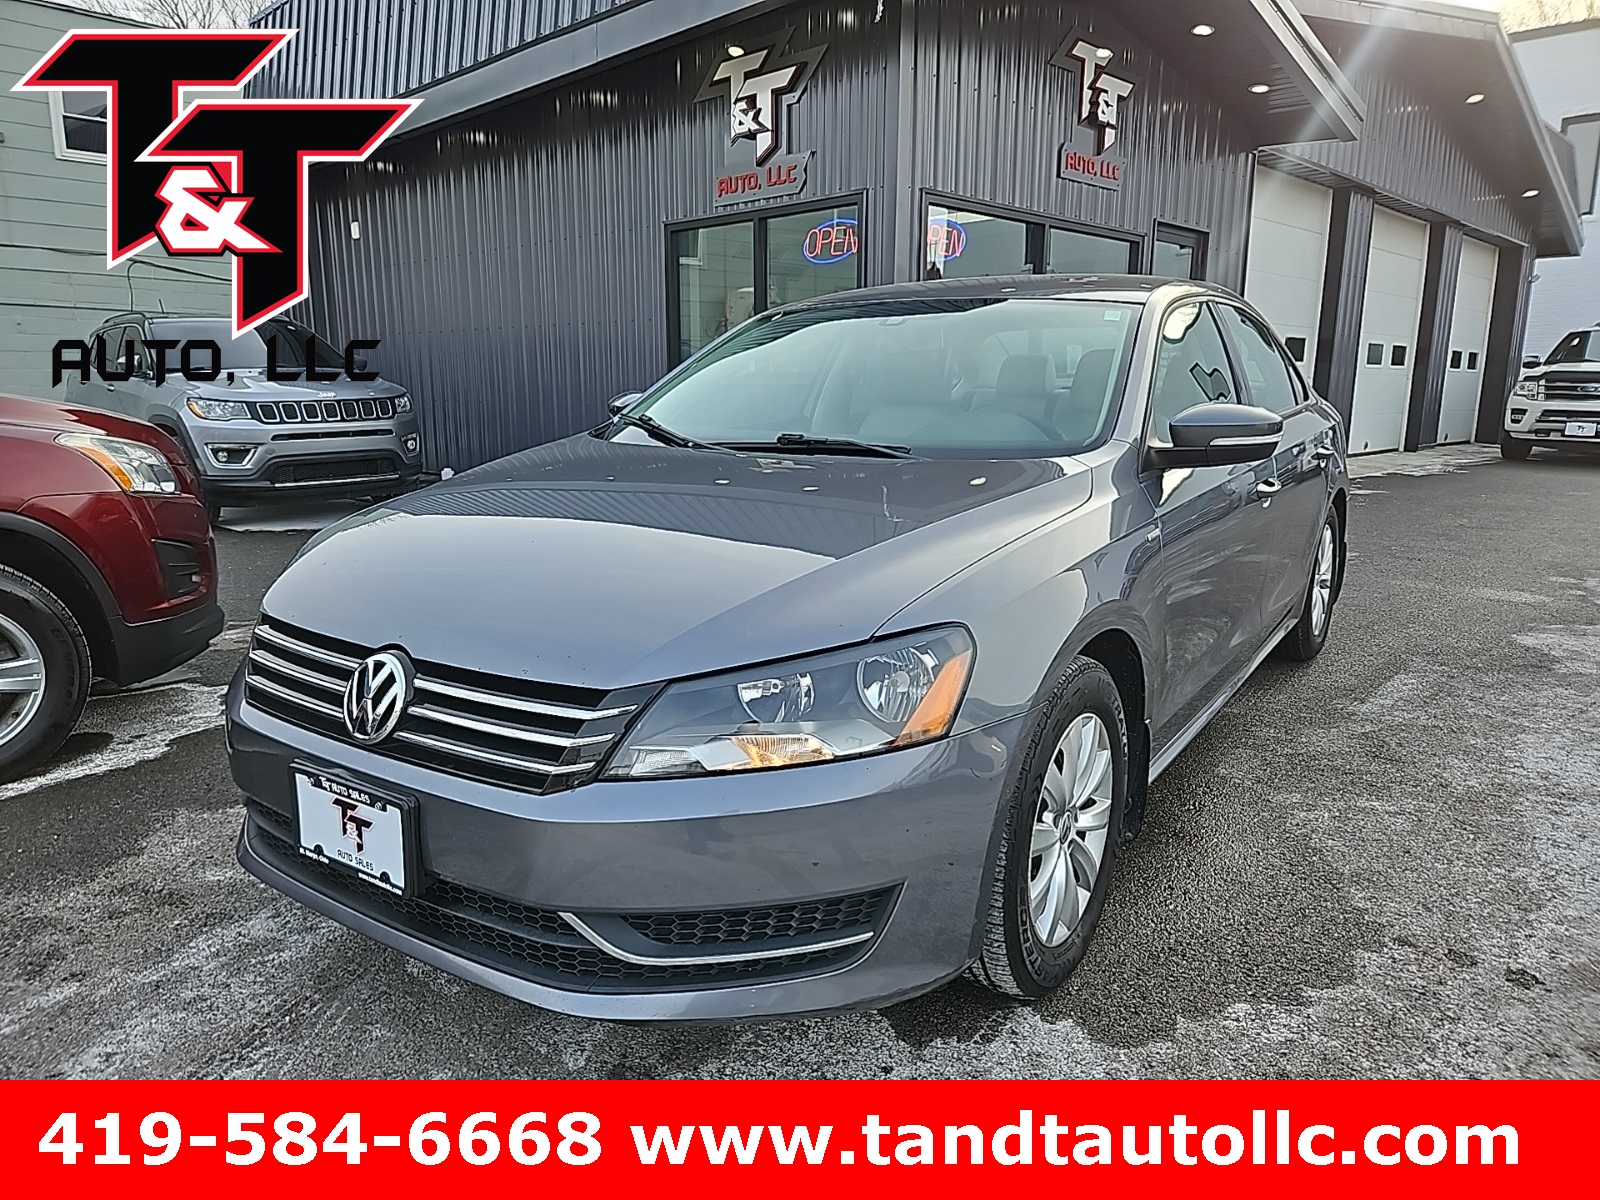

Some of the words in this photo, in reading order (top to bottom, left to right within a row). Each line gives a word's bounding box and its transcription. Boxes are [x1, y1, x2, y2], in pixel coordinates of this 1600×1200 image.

[766, 164, 798, 187] LLC
[1100, 159, 1120, 181] LLC
[806, 225, 858, 257] OPEN
[927, 224, 964, 257] PEN
[337, 849, 353, 862] AUTO
[355, 856, 374, 872] SALES
